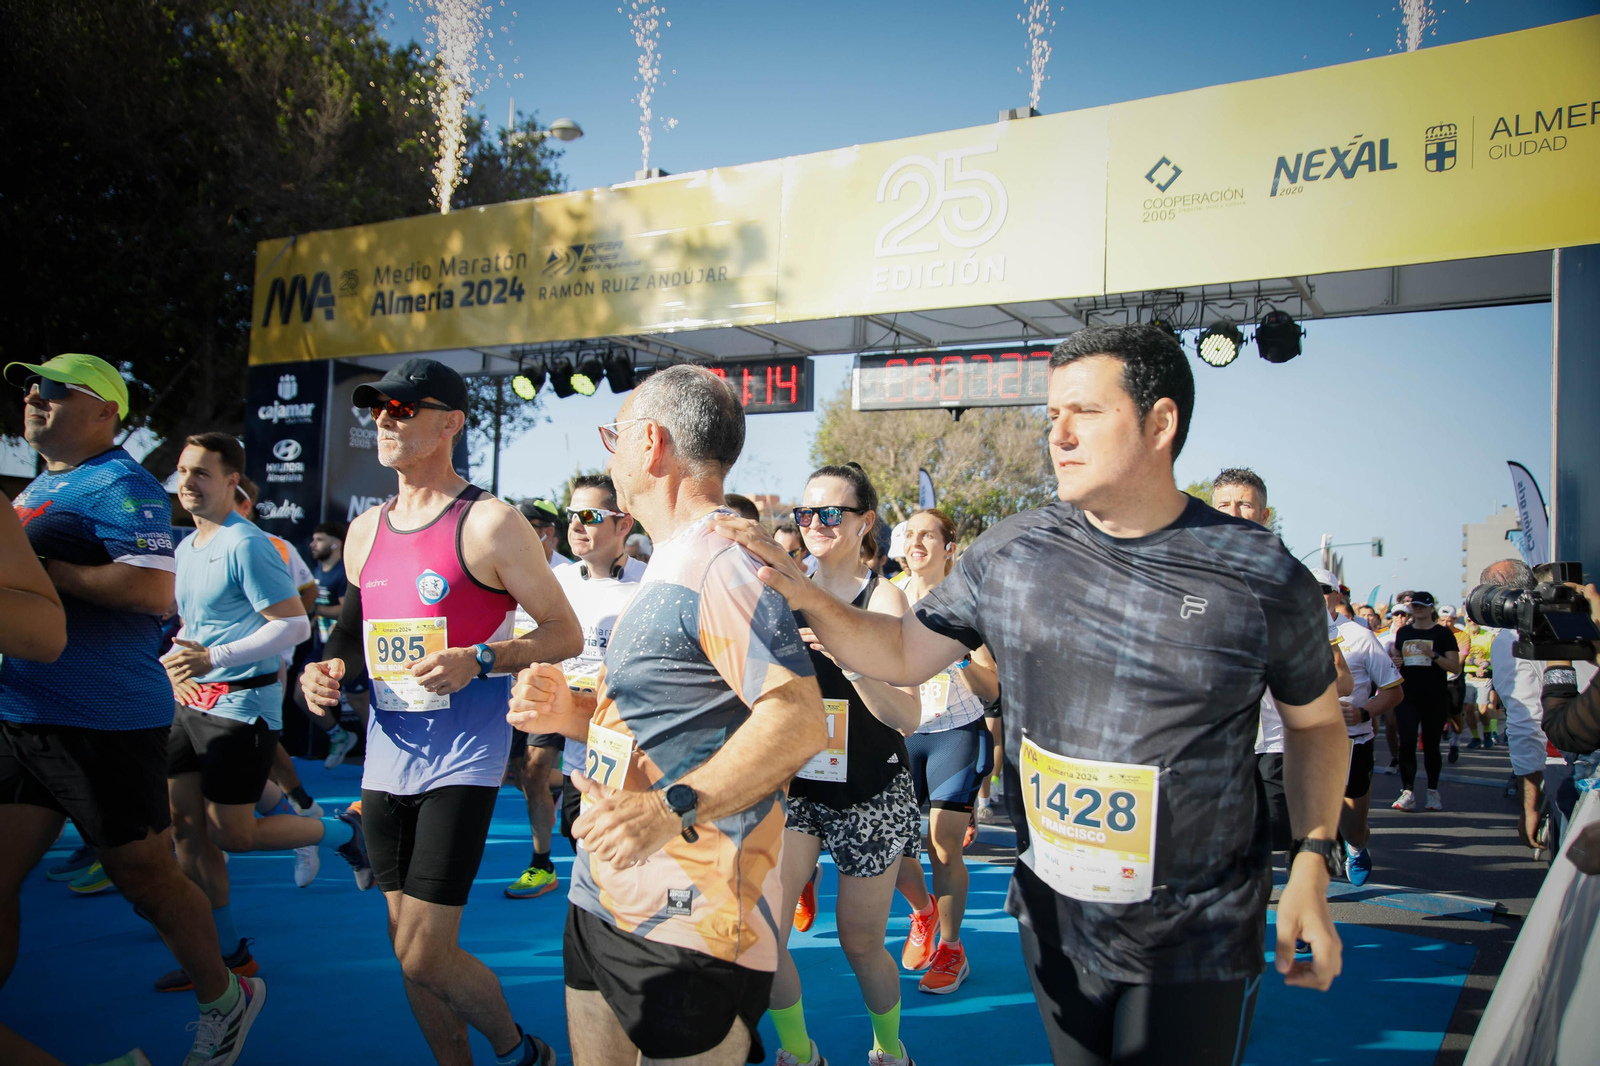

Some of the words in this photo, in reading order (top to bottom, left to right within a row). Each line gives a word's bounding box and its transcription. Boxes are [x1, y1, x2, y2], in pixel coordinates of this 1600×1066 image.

[1489, 135, 1568, 160] CIUDAD
[1270, 134, 1398, 197] NEXAL
[873, 143, 1009, 258] 25
[1143, 187, 1244, 210] COOPERACIÓN
[1279, 185, 1304, 196] 2020
[1142, 209, 1176, 223] 2005
[373, 260, 431, 286] Medio
[438, 250, 527, 278] Maratón
[872, 251, 1006, 292] EDICIÓN
[370, 283, 454, 316] Almería
[460, 275, 525, 307] 2024
[539, 279, 595, 300] RAMÓN
[601, 277, 640, 294] RUIZ
[646, 266, 728, 289] ANDÚJAR
[258, 400, 316, 424] cajamar
[137, 538, 172, 551] egea
[589, 626, 613, 636] Mara
[377, 636, 426, 662] 985
[1075, 772, 1099, 782] 2024
[1030, 772, 1136, 832] 1428
[1041, 815, 1106, 844] FRANCISCO
